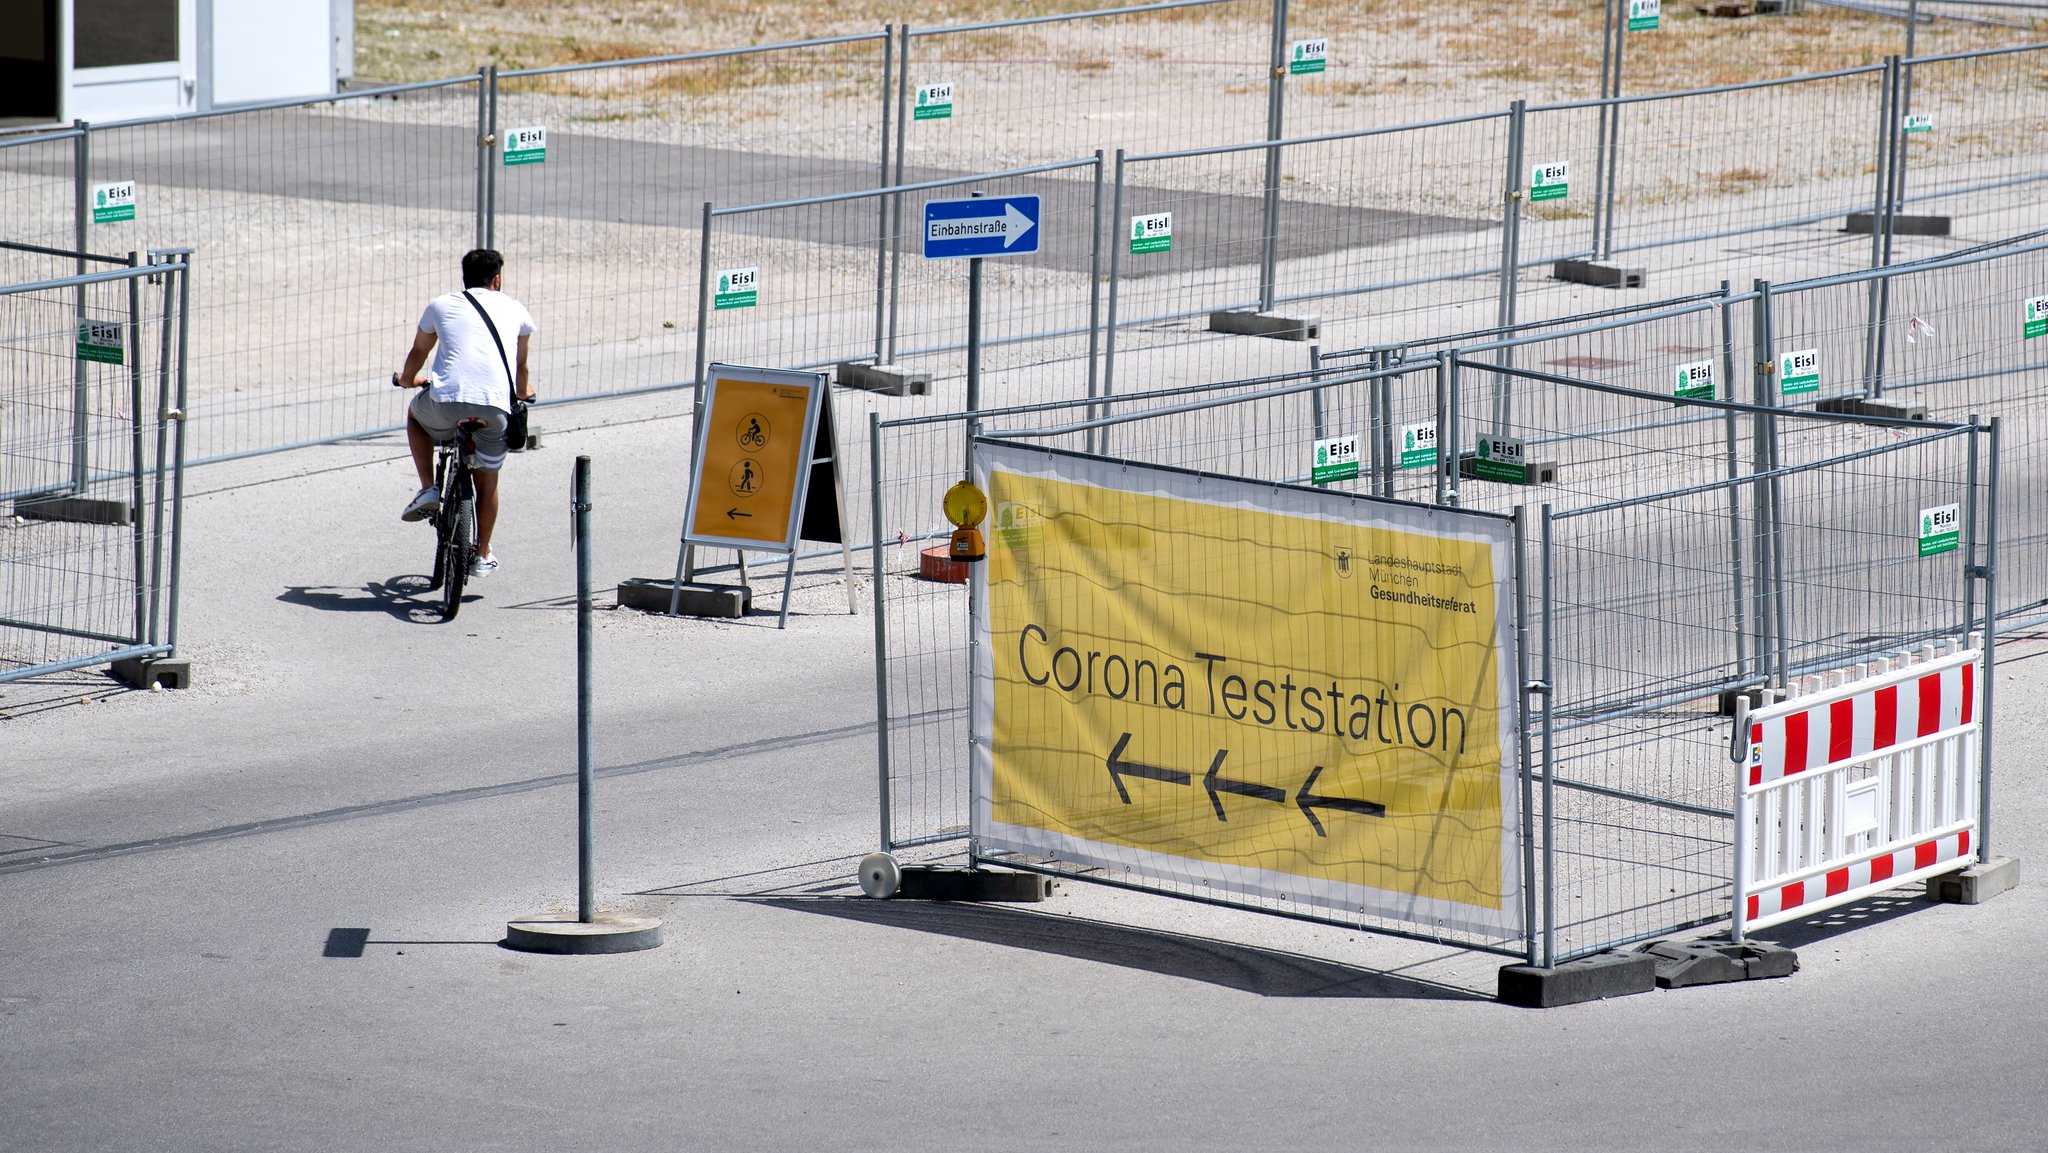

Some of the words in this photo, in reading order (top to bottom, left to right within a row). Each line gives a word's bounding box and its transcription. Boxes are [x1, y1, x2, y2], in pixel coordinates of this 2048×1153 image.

[1641, 0, 1658, 10] Eisl
[1305, 42, 1325, 54] Eisl
[930, 87, 950, 99] Eisl
[520, 130, 542, 142] Eisl
[1545, 165, 1566, 178] Eisl
[109, 186, 131, 199] Eisl
[931, 220, 1007, 237] Einbahnstraße
[1147, 217, 1168, 230] Eisl
[732, 271, 754, 285] Eisl
[2036, 299, 2048, 311] Eis
[92, 325, 118, 339] Eisl
[1794, 353, 1815, 368] Eisl
[1690, 364, 1711, 380] Eisl
[1417, 427, 1436, 441] Eis
[1330, 440, 1354, 456] Eisl
[1492, 440, 1520, 457] Eisl
[1934, 508, 1956, 526] Eisl
[1368, 550, 1462, 577] Landeshauptstadt
[1369, 567, 1419, 588] München
[1370, 585, 1476, 614] Gesundheitsreferat
[1019, 624, 1186, 710] Corona
[1195, 652, 1465, 754] Teststation
